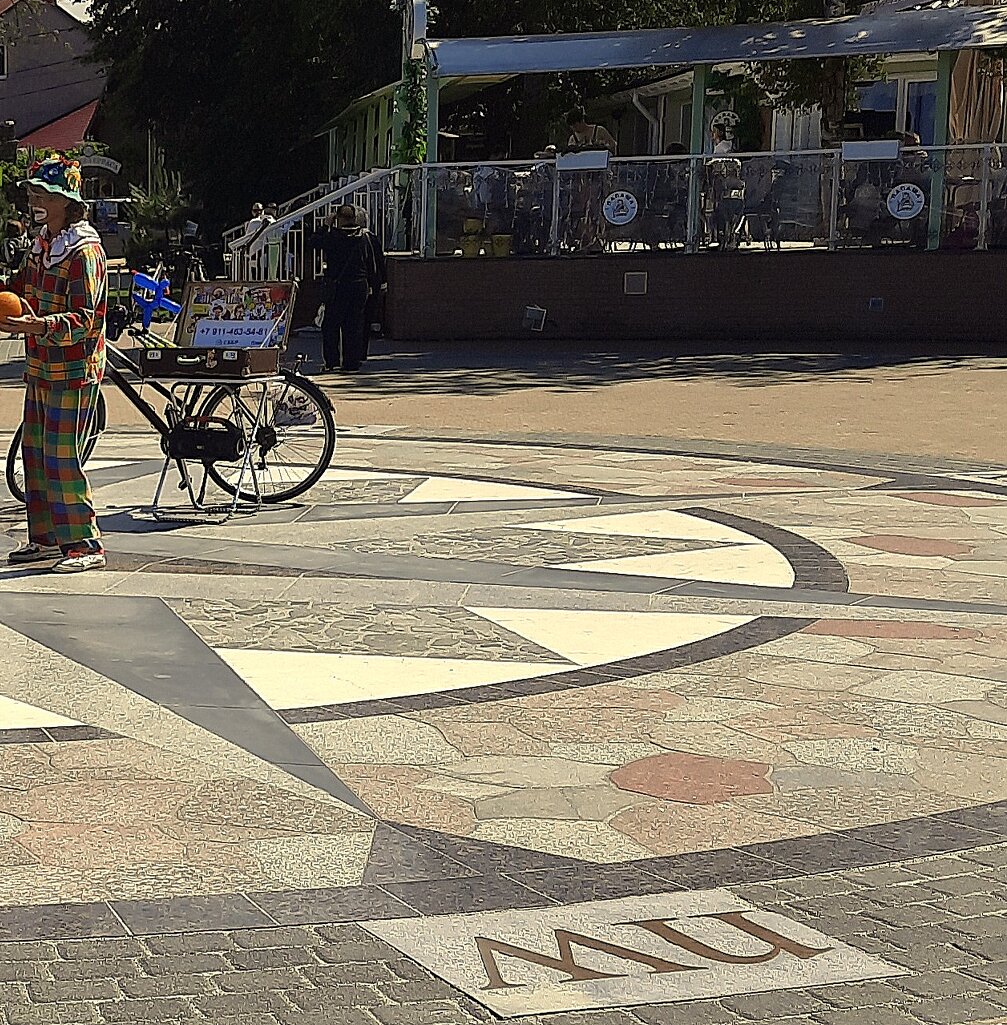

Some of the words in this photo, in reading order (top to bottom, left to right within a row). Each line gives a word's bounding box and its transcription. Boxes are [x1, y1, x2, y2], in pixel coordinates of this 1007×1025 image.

[891, 186, 920, 199] ПАПАША
[606, 193, 634, 206] ПАПАША
[200, 327, 210, 336] +7
